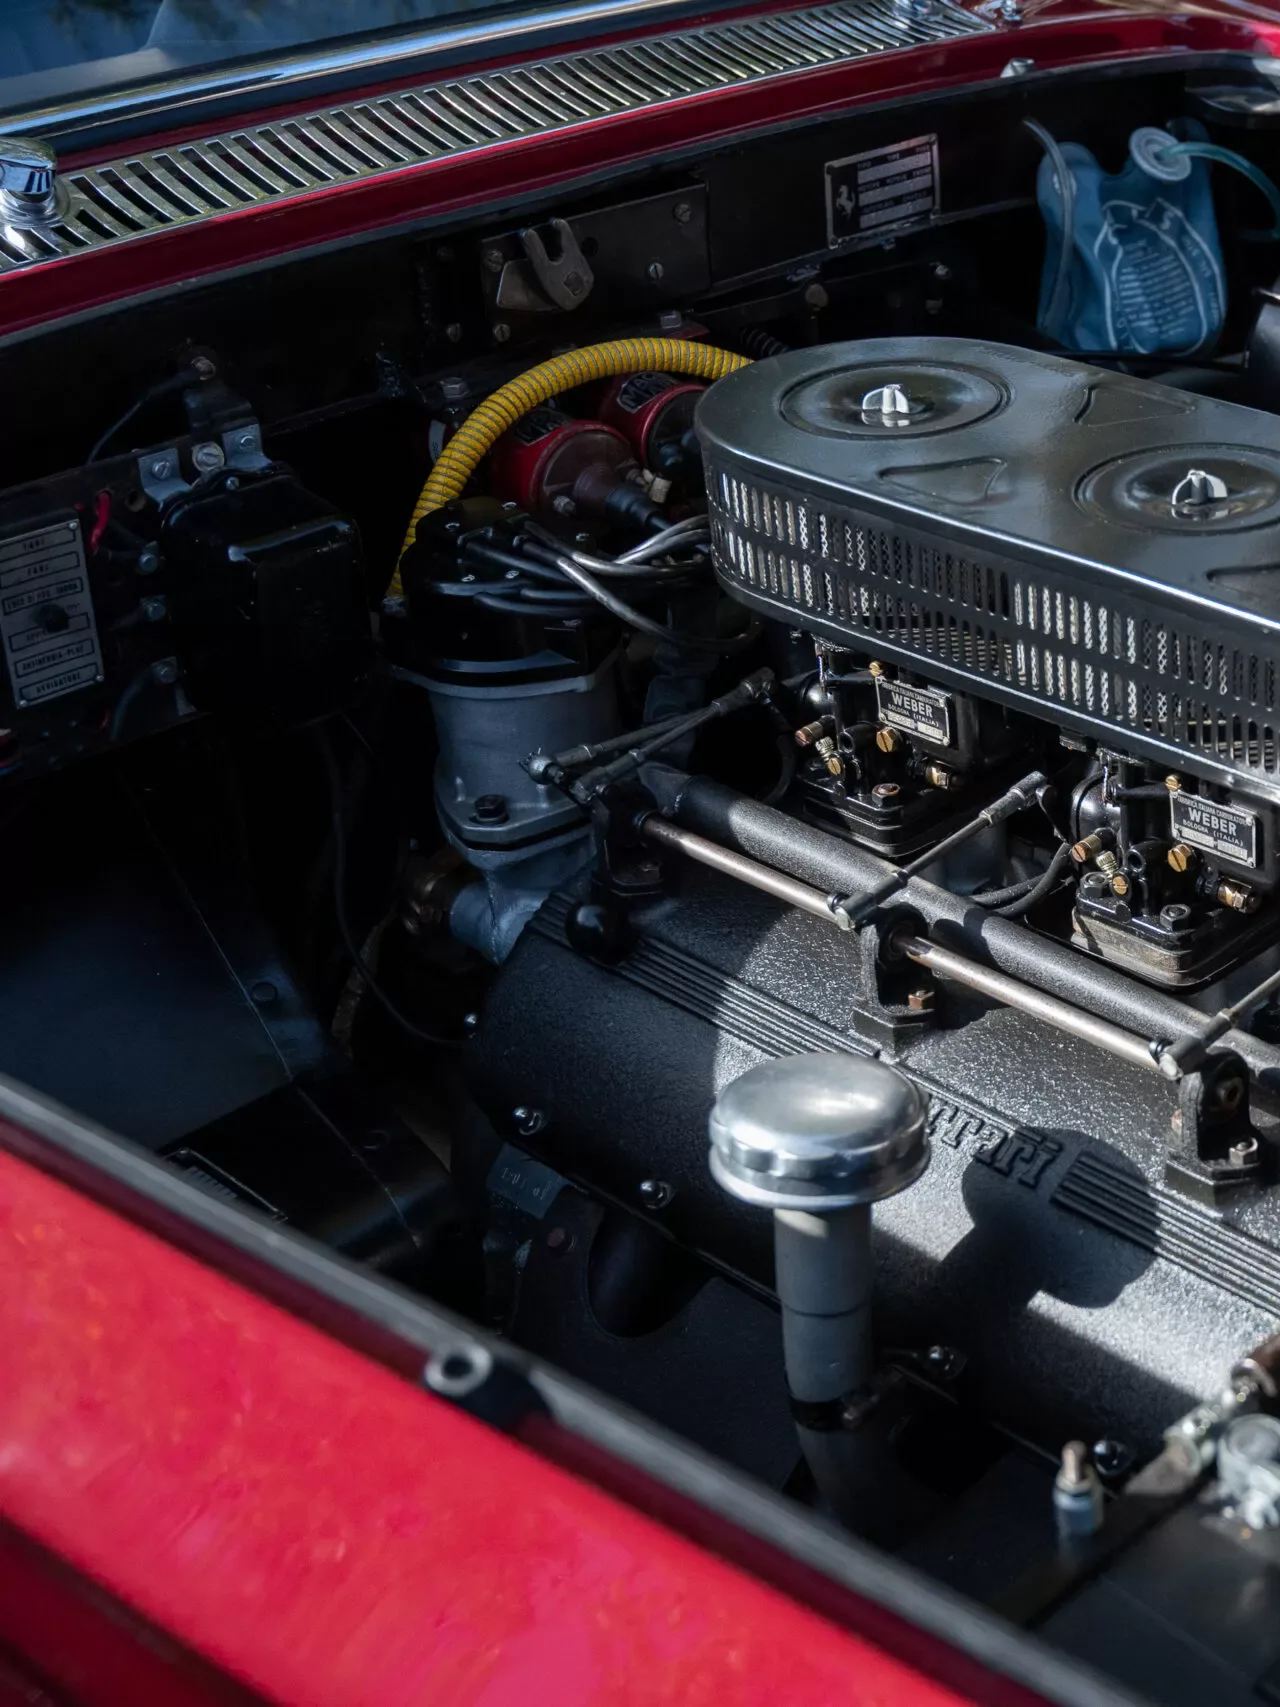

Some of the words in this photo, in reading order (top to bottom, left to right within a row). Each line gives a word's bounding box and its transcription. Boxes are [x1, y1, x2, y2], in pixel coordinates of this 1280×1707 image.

[887, 703, 911, 718] BOLOGNA
[913, 713, 939, 728] (ITALIA)
[891, 692, 933, 719] WEBER
[1182, 819, 1209, 834] BOLOGNA
[1213, 831, 1244, 846] (ITALIA)
[1188, 807, 1236, 836] WEBER
